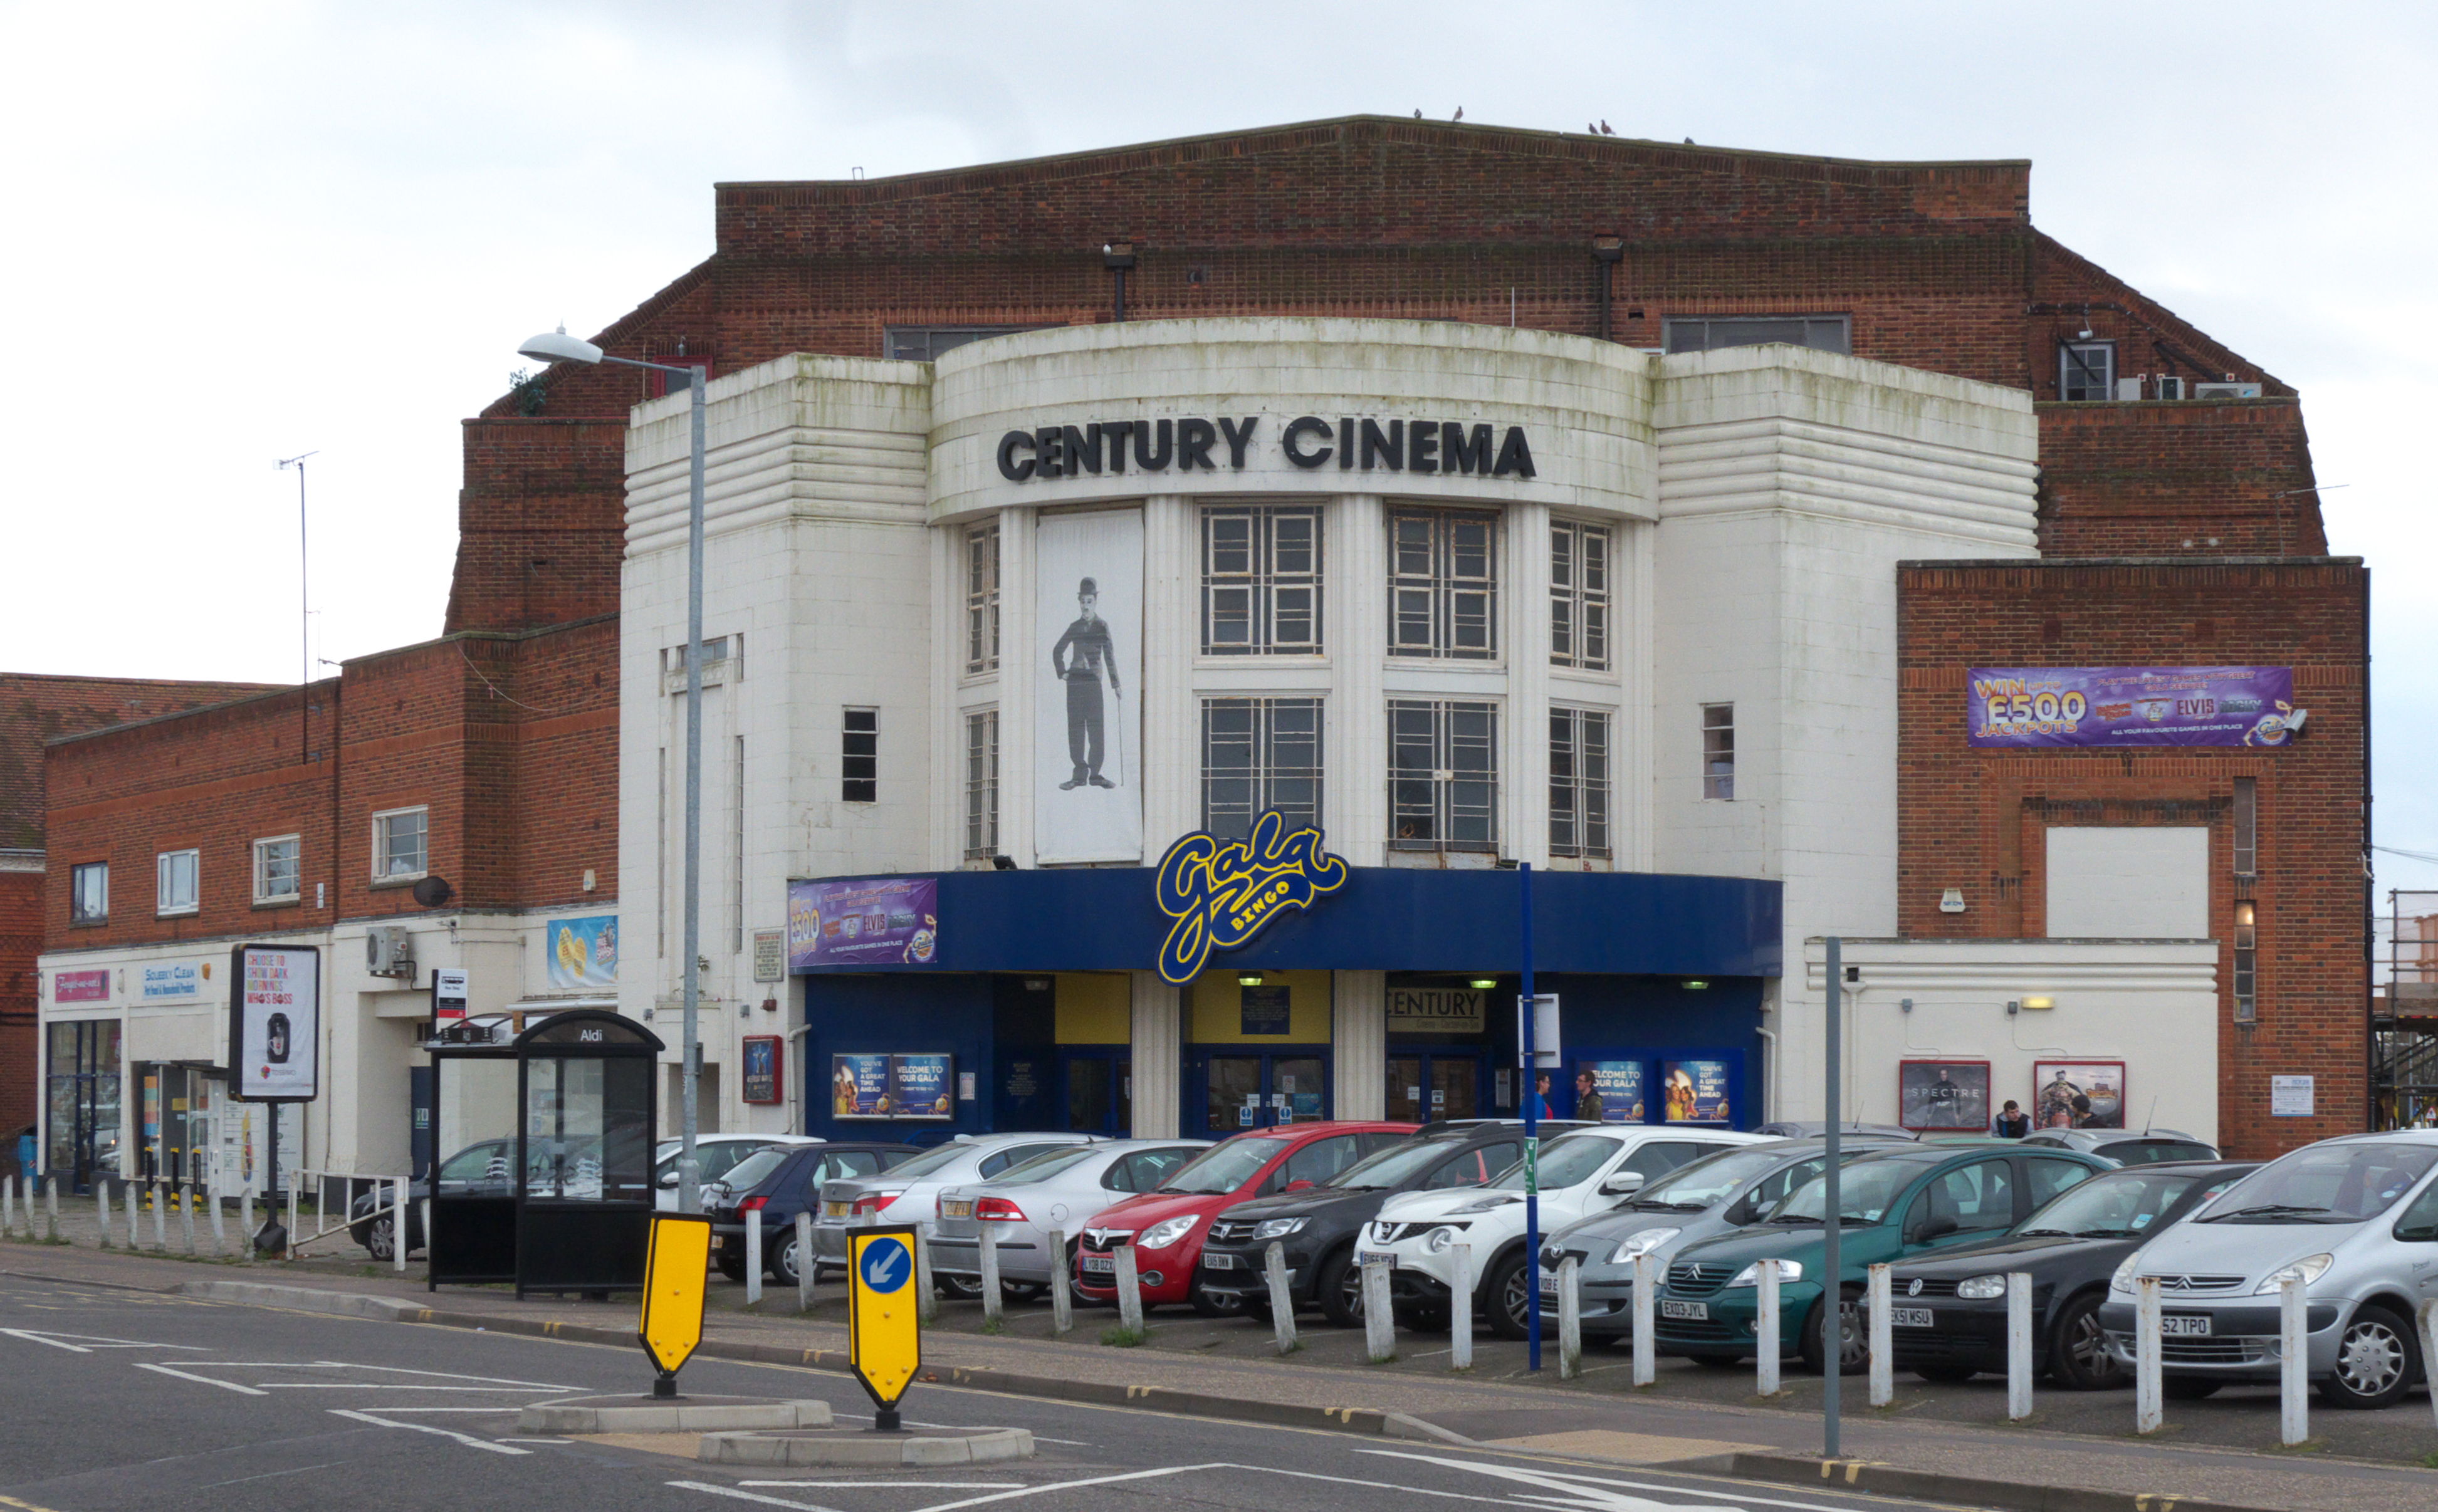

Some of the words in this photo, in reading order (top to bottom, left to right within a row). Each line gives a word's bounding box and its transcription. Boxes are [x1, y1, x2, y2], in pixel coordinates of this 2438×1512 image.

[997, 417, 1259, 481] CENTURY
[1282, 416, 1537, 477] CINEMA
[1974, 678, 2025, 699] WIN
[2045, 681, 2063, 689] TO
[1987, 691, 2086, 724] £500
[2177, 699, 2214, 715] ELVIS
[1975, 719, 2078, 738] JACKPOTS
[1156, 811, 1347, 983] Gala
[1231, 881, 1290, 931] BINGO
[863, 914, 886, 932] ELVIS
[248, 954, 274, 966] CHOOSE
[276, 955, 285, 966] TO
[269, 967, 288, 979] DARK
[580, 1029, 602, 1041] Aldi
[897, 1065, 929, 1073] WELCOME
[1629, 1071, 1641, 1079] TO
[898, 1074, 916, 1082] YOUR
[918, 1074, 939, 1082] GALA
[1593, 1079, 1610, 1087] OUR
[1613, 1079, 1637, 1087] GALA
[1911, 1088, 1980, 1098] SPECTRE
[2162, 1318, 2178, 1333] 52
[2181, 1318, 2207, 1334] TPO
